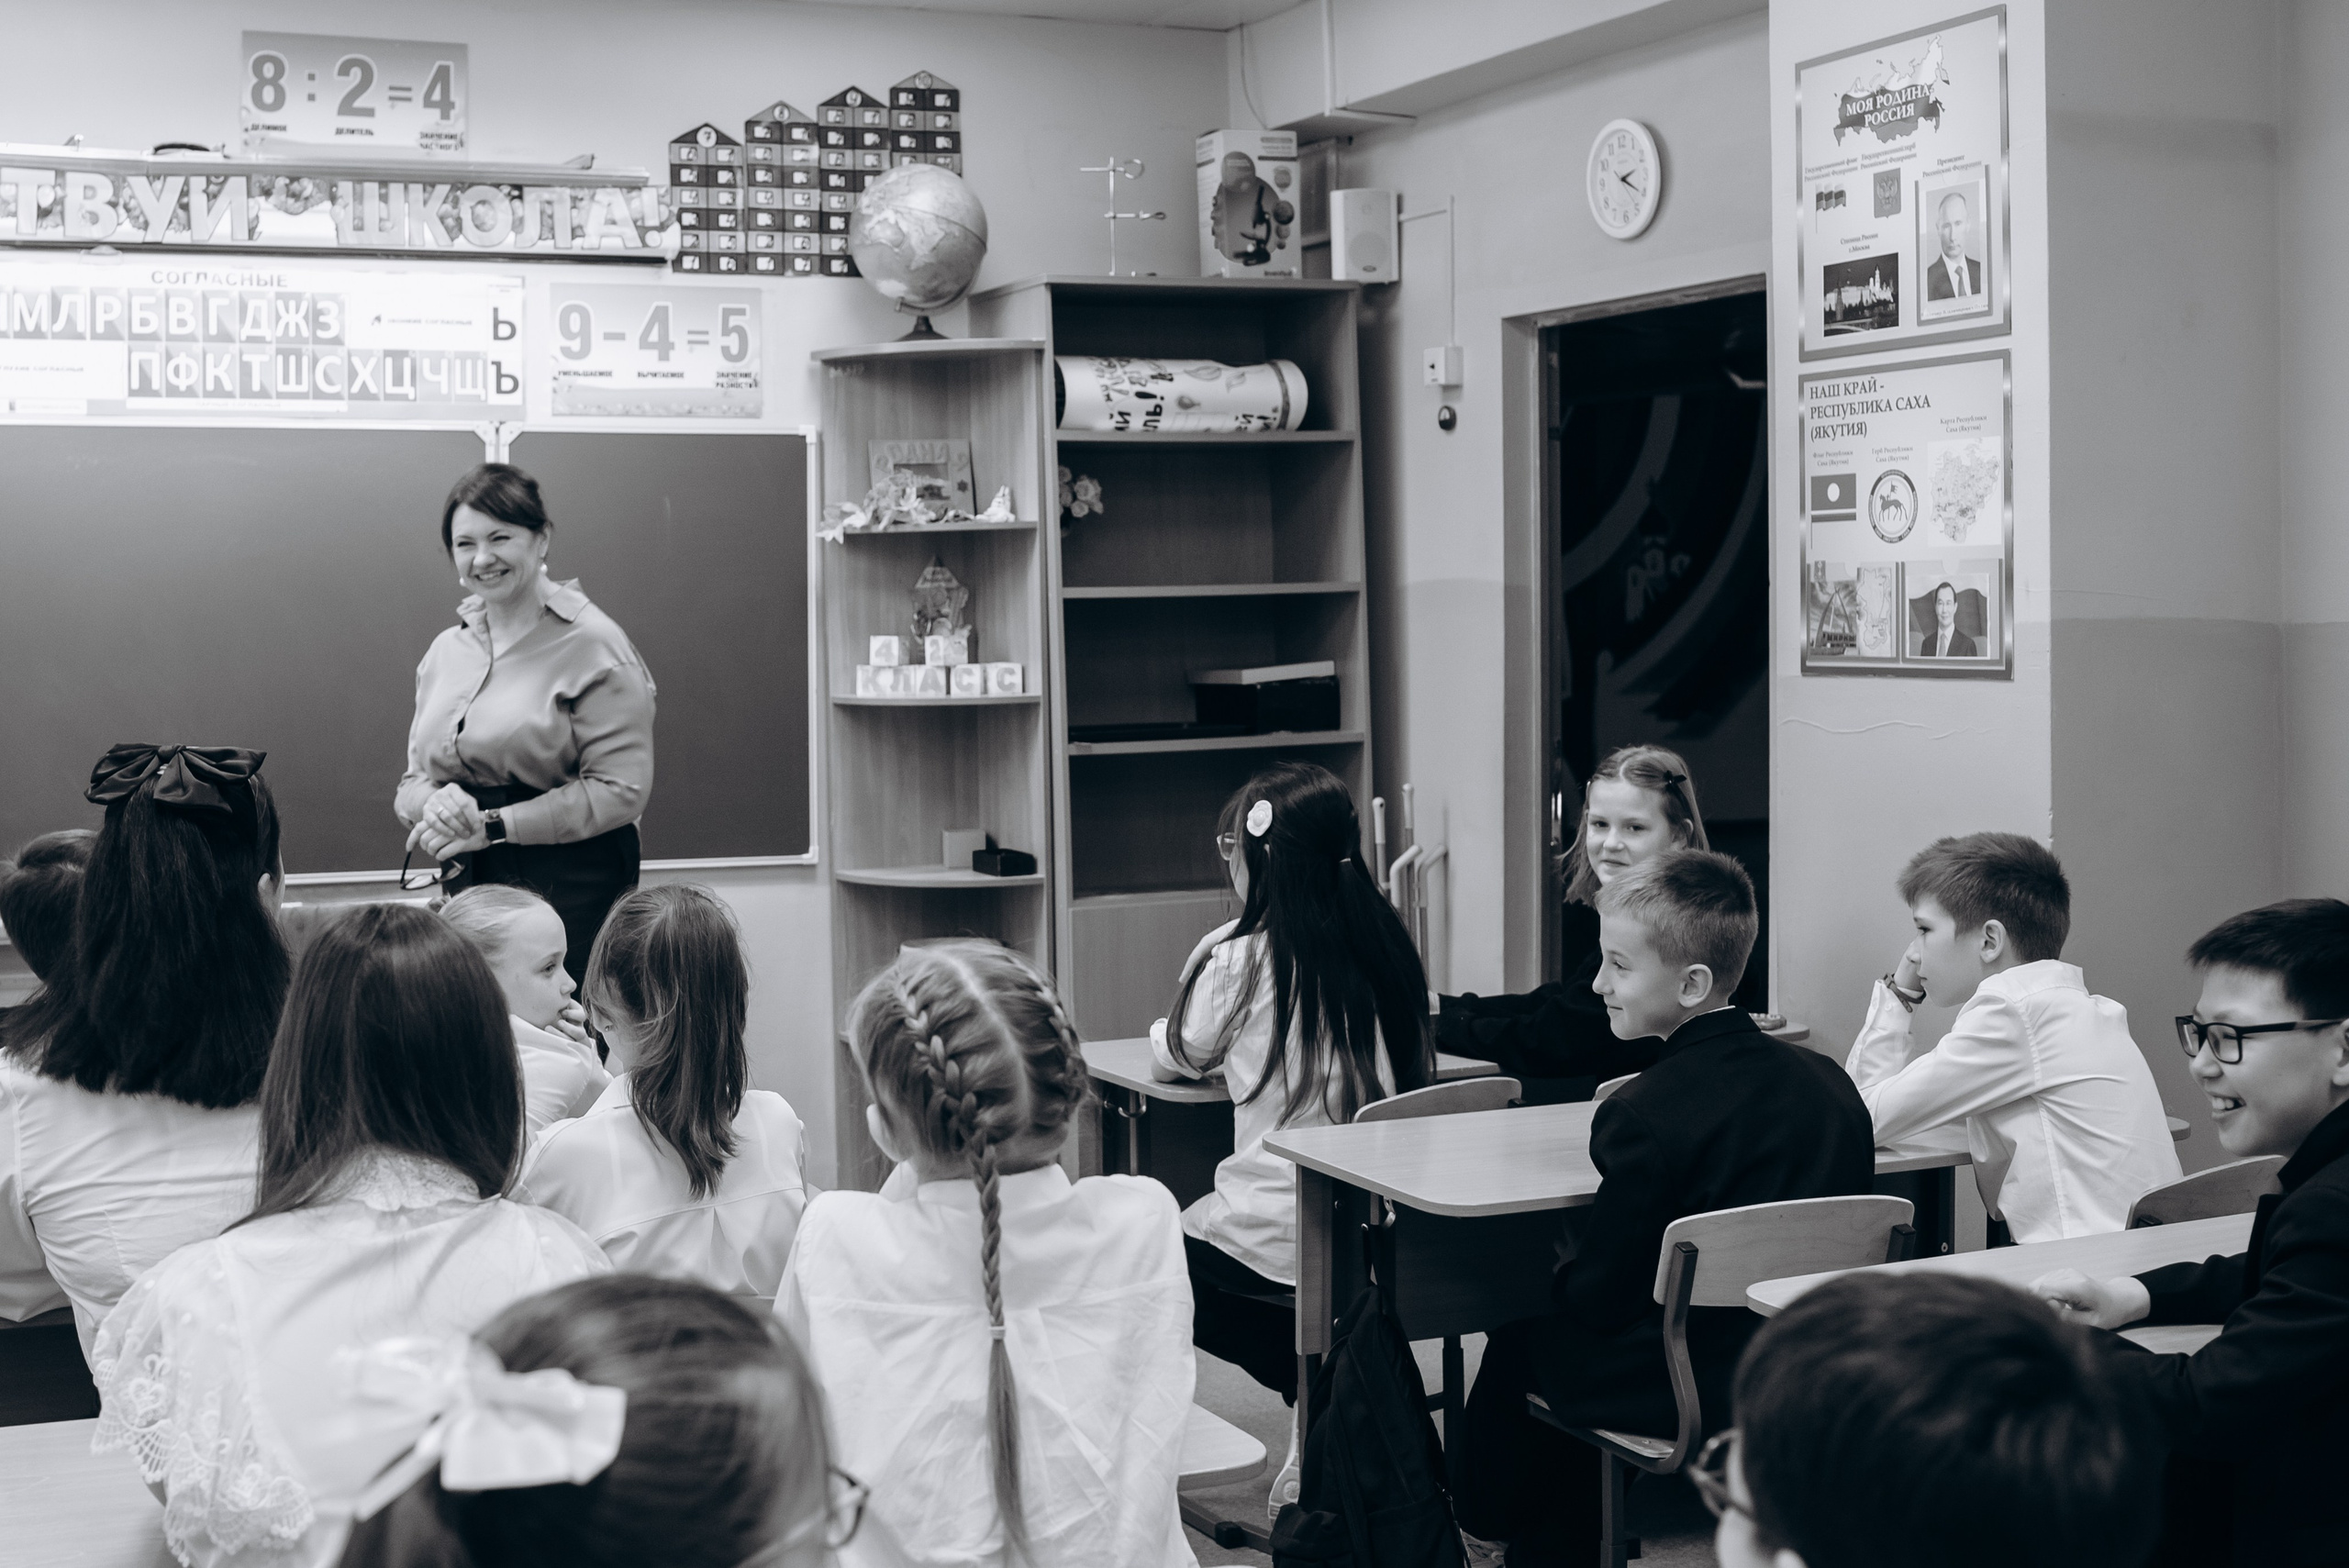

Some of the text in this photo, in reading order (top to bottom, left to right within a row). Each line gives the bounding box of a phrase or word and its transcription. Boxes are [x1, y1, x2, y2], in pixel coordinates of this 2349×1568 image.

[1846, 97, 1874, 117] МОЯ
[1864, 103, 1915, 128] РОССИЯ
[334, 127, 374, 137] ДЕЛИТЕЛЬ
[1608, 142, 1614, 156] 11
[1618, 134, 1627, 150] 12
[1600, 158, 1609, 172] 10
[1936, 154, 1965, 166] Президент
[1599, 177, 1606, 192] 9
[1603, 195, 1609, 210] 8
[337, 180, 663, 250] ШКОЛА!
[1623, 210, 1630, 224] 6
[150, 270, 288, 287] СОГЛАСНЫЕ
[493, 306, 517, 341] Ь
[491, 361, 519, 395] Ъ
[558, 370, 613, 378] УМЕНЬШАЕМОЕ
[1809, 384, 1841, 399] НАШ
[1843, 376, 1878, 396] КРАЙ
[1810, 395, 1932, 420] РЕСПУБЛИКА САХА
[1940, 415, 1987, 426] Карта Республики
[1810, 421, 1867, 443] (ЯКУТИЯ)
[1958, 424, 1981, 433] (Якутия)
[1872, 446, 1913, 455] Герб Республики
[874, 639, 941, 662] 4 2
